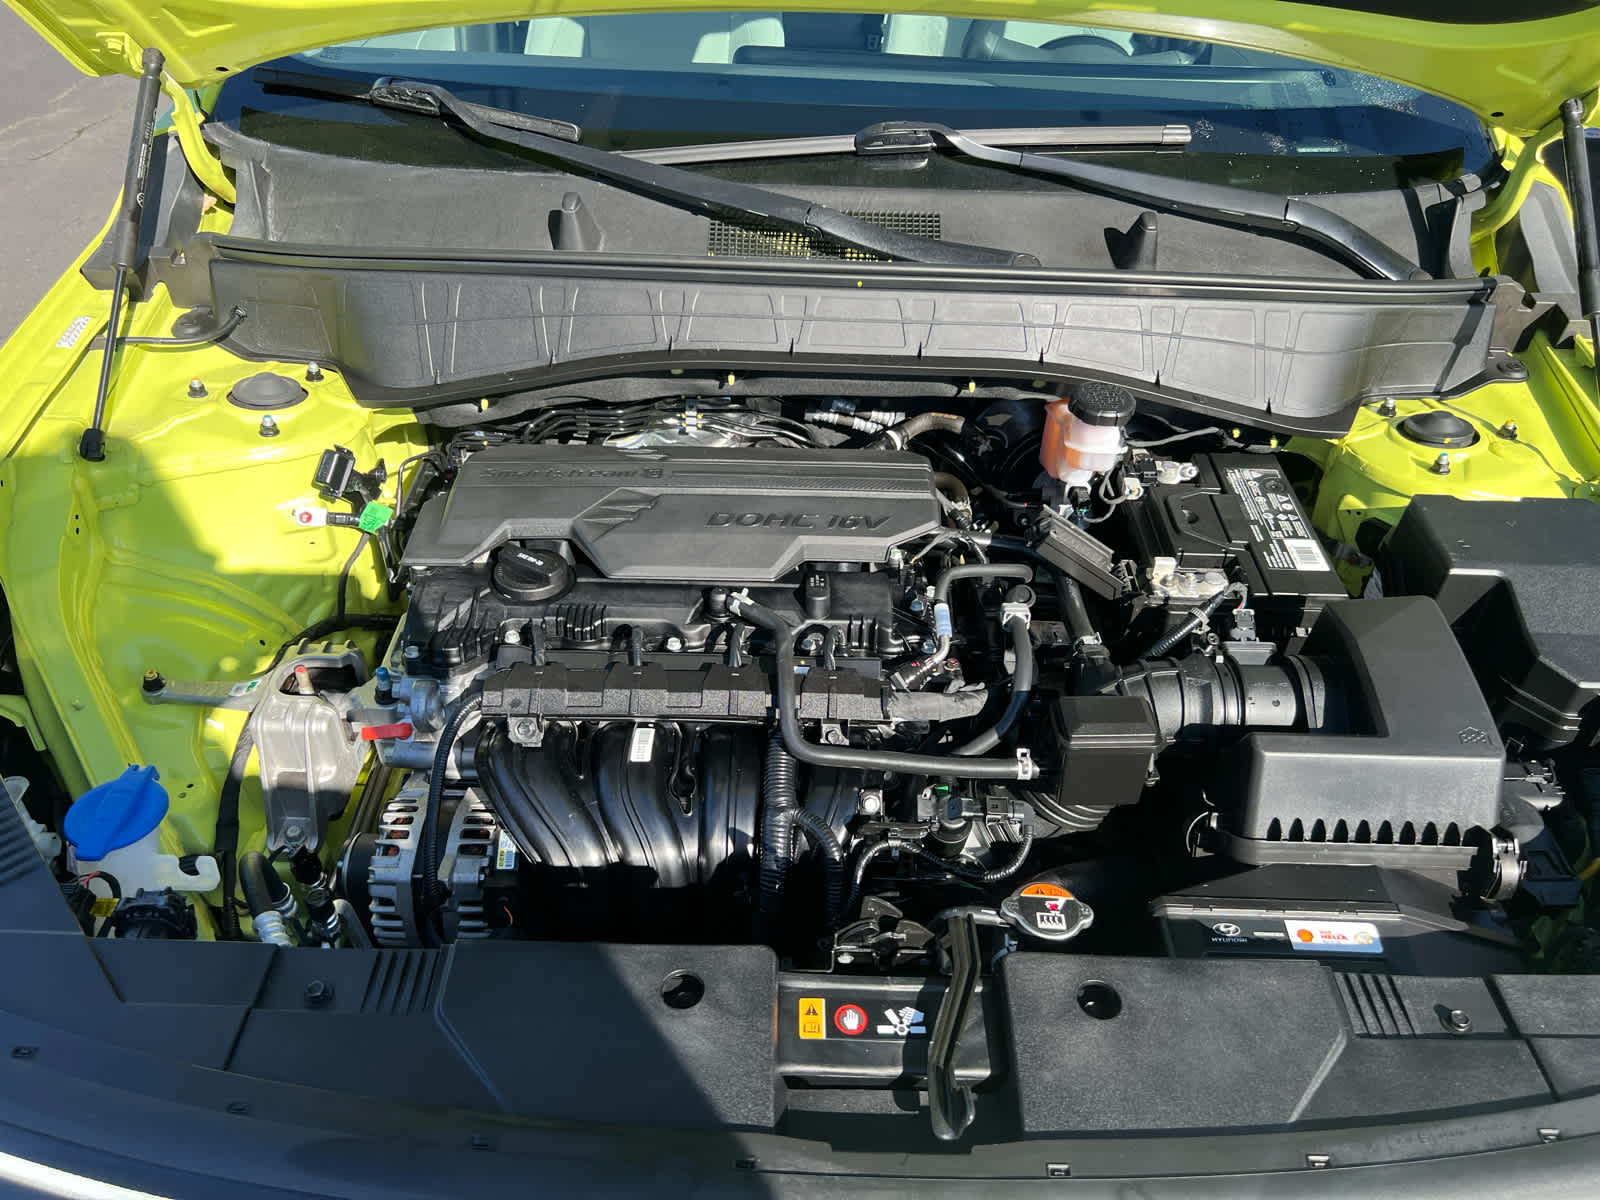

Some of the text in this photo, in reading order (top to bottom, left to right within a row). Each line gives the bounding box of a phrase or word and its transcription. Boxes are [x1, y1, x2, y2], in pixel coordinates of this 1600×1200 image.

[479, 466, 637, 480] Smartstream
[704, 512, 892, 530] DOHC 16V
